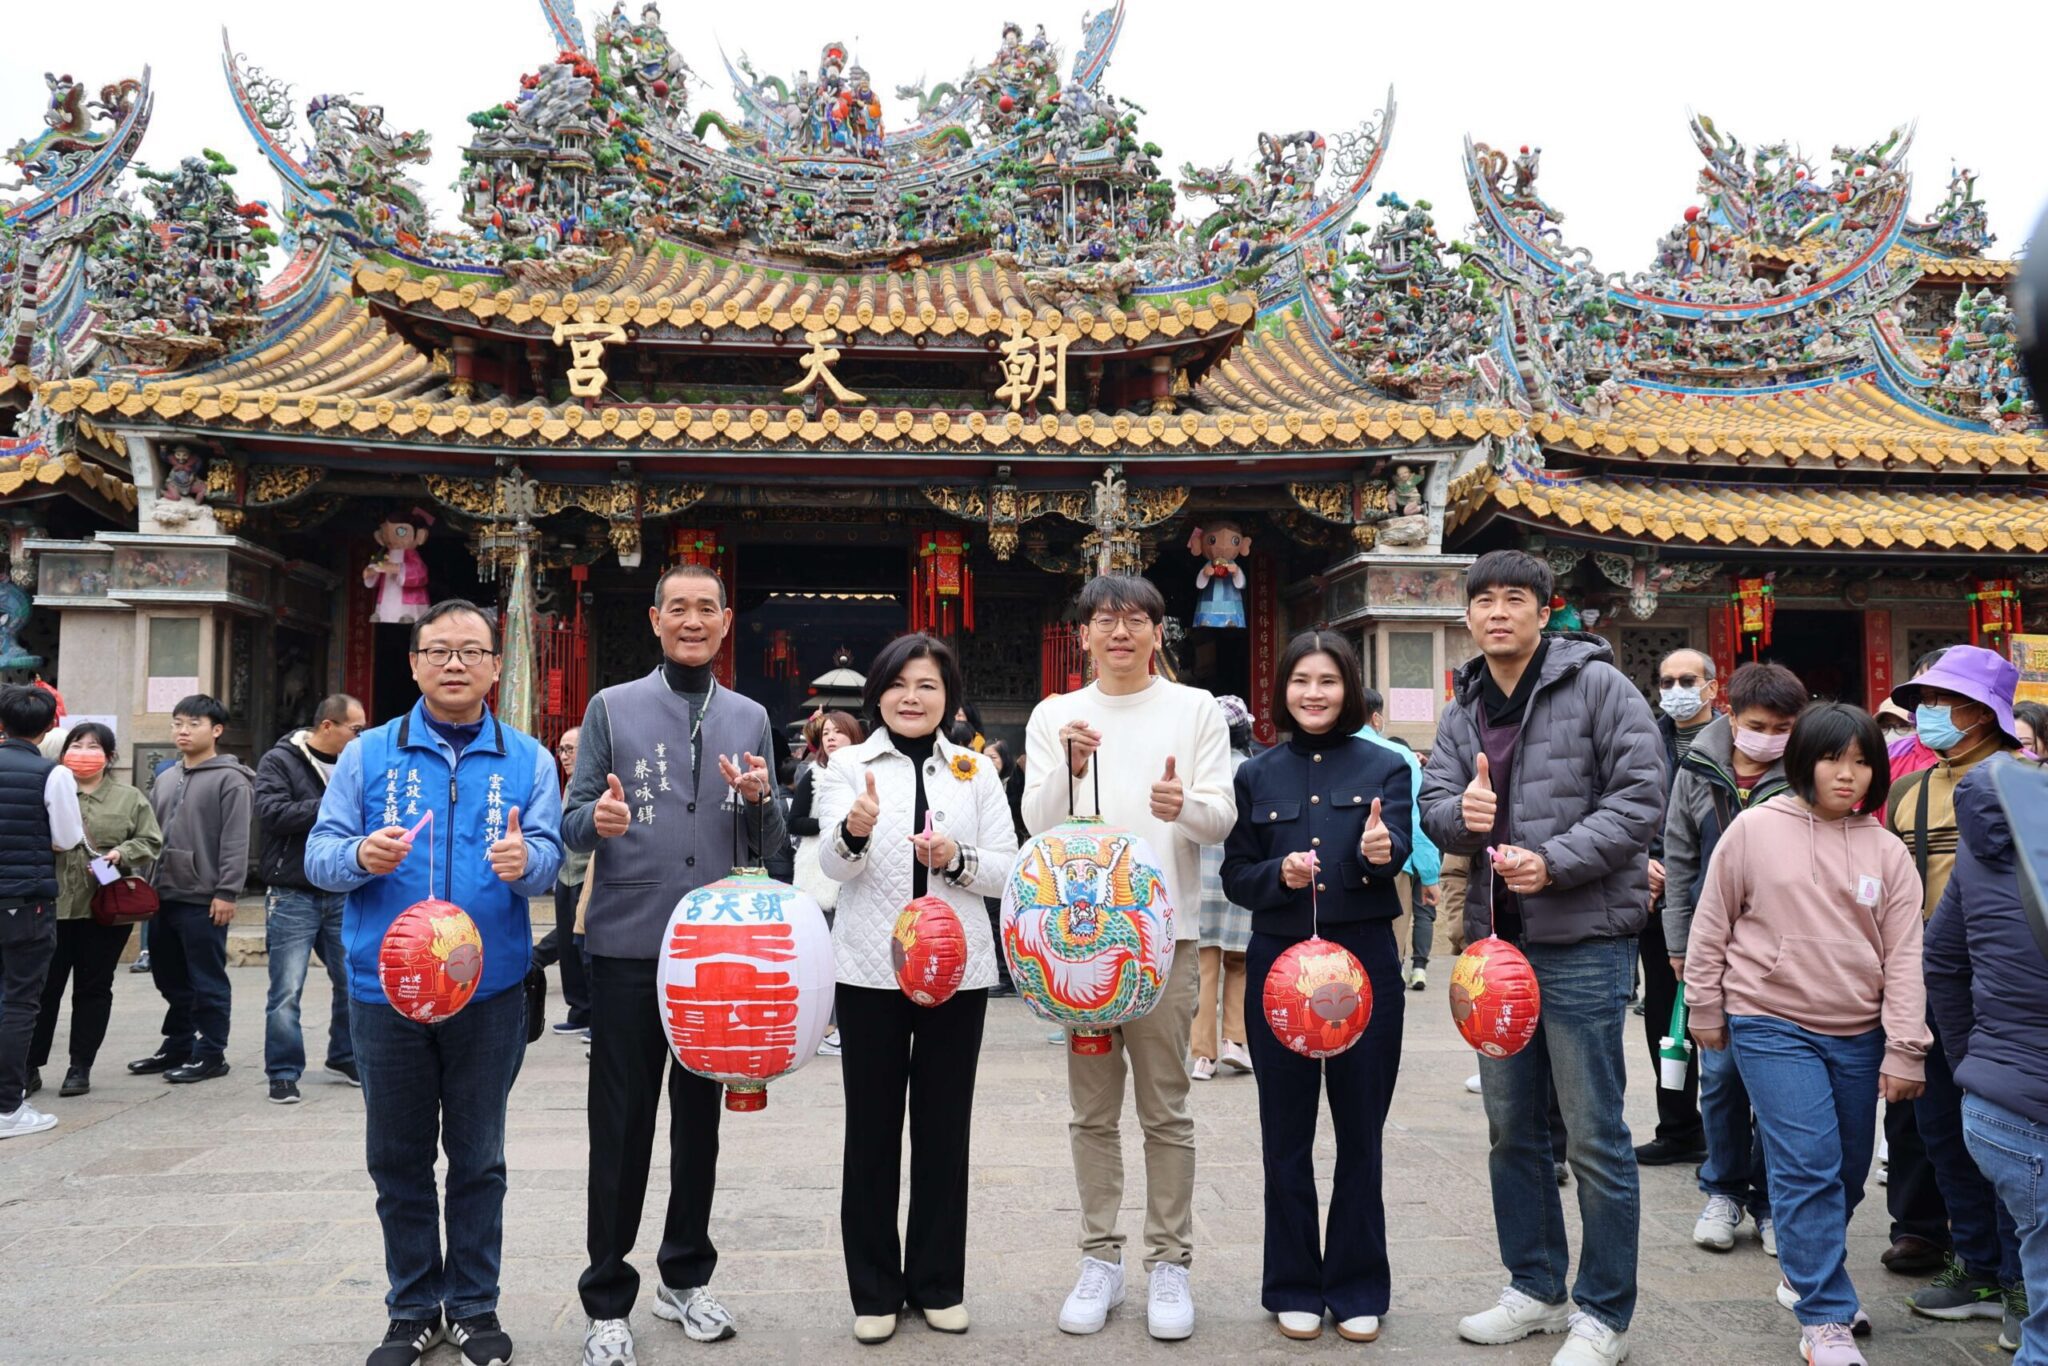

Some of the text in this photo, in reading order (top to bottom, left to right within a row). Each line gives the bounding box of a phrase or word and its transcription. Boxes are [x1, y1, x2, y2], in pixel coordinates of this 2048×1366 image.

[654, 743, 672, 791] 董事長
[383, 768, 402, 826] 副處長蘇
[405, 768, 422, 815] 民政處
